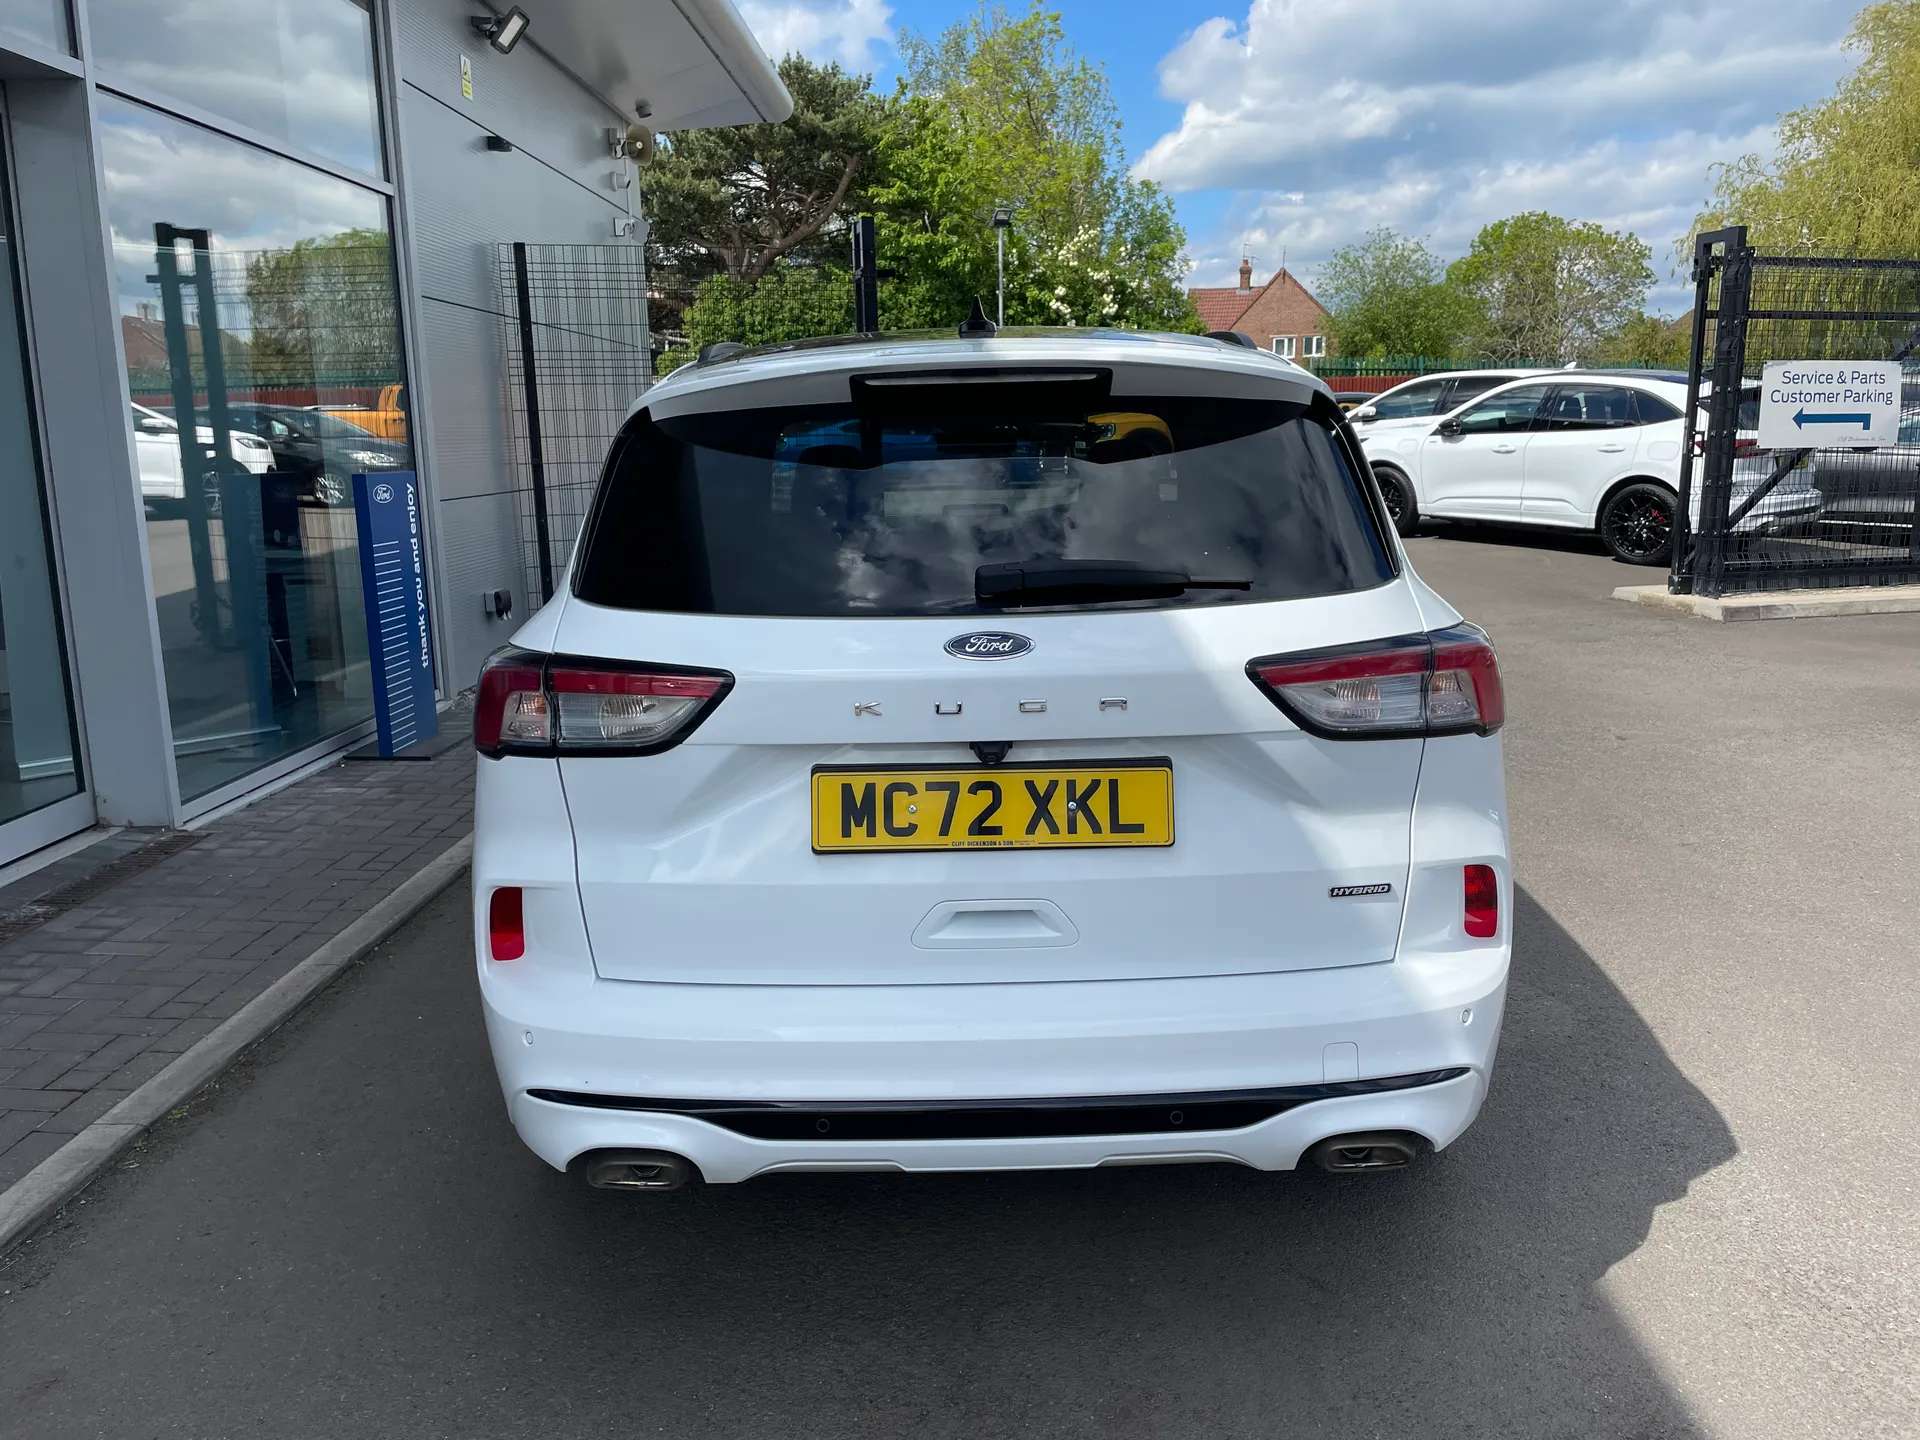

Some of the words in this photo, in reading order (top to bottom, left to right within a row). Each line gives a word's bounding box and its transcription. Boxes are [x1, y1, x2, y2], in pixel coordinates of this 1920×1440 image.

[1782, 371, 1833, 384] Service
[1837, 371, 1847, 384] &
[1851, 371, 1886, 384] Parts
[1770, 389, 1840, 403] Customer
[1844, 389, 1893, 405] Parking
[377, 486, 391, 501] Ford
[406, 482, 418, 535] enjoy
[411, 538, 422, 574] and
[415, 577, 425, 611] you
[418, 614, 429, 669] thank
[965, 635, 1014, 653] Ford
[854, 696, 1128, 717] KUGA
[840, 780, 1004, 839] MC72
[1024, 778, 1145, 836] XKL
[1332, 884, 1389, 896] HYBRID
